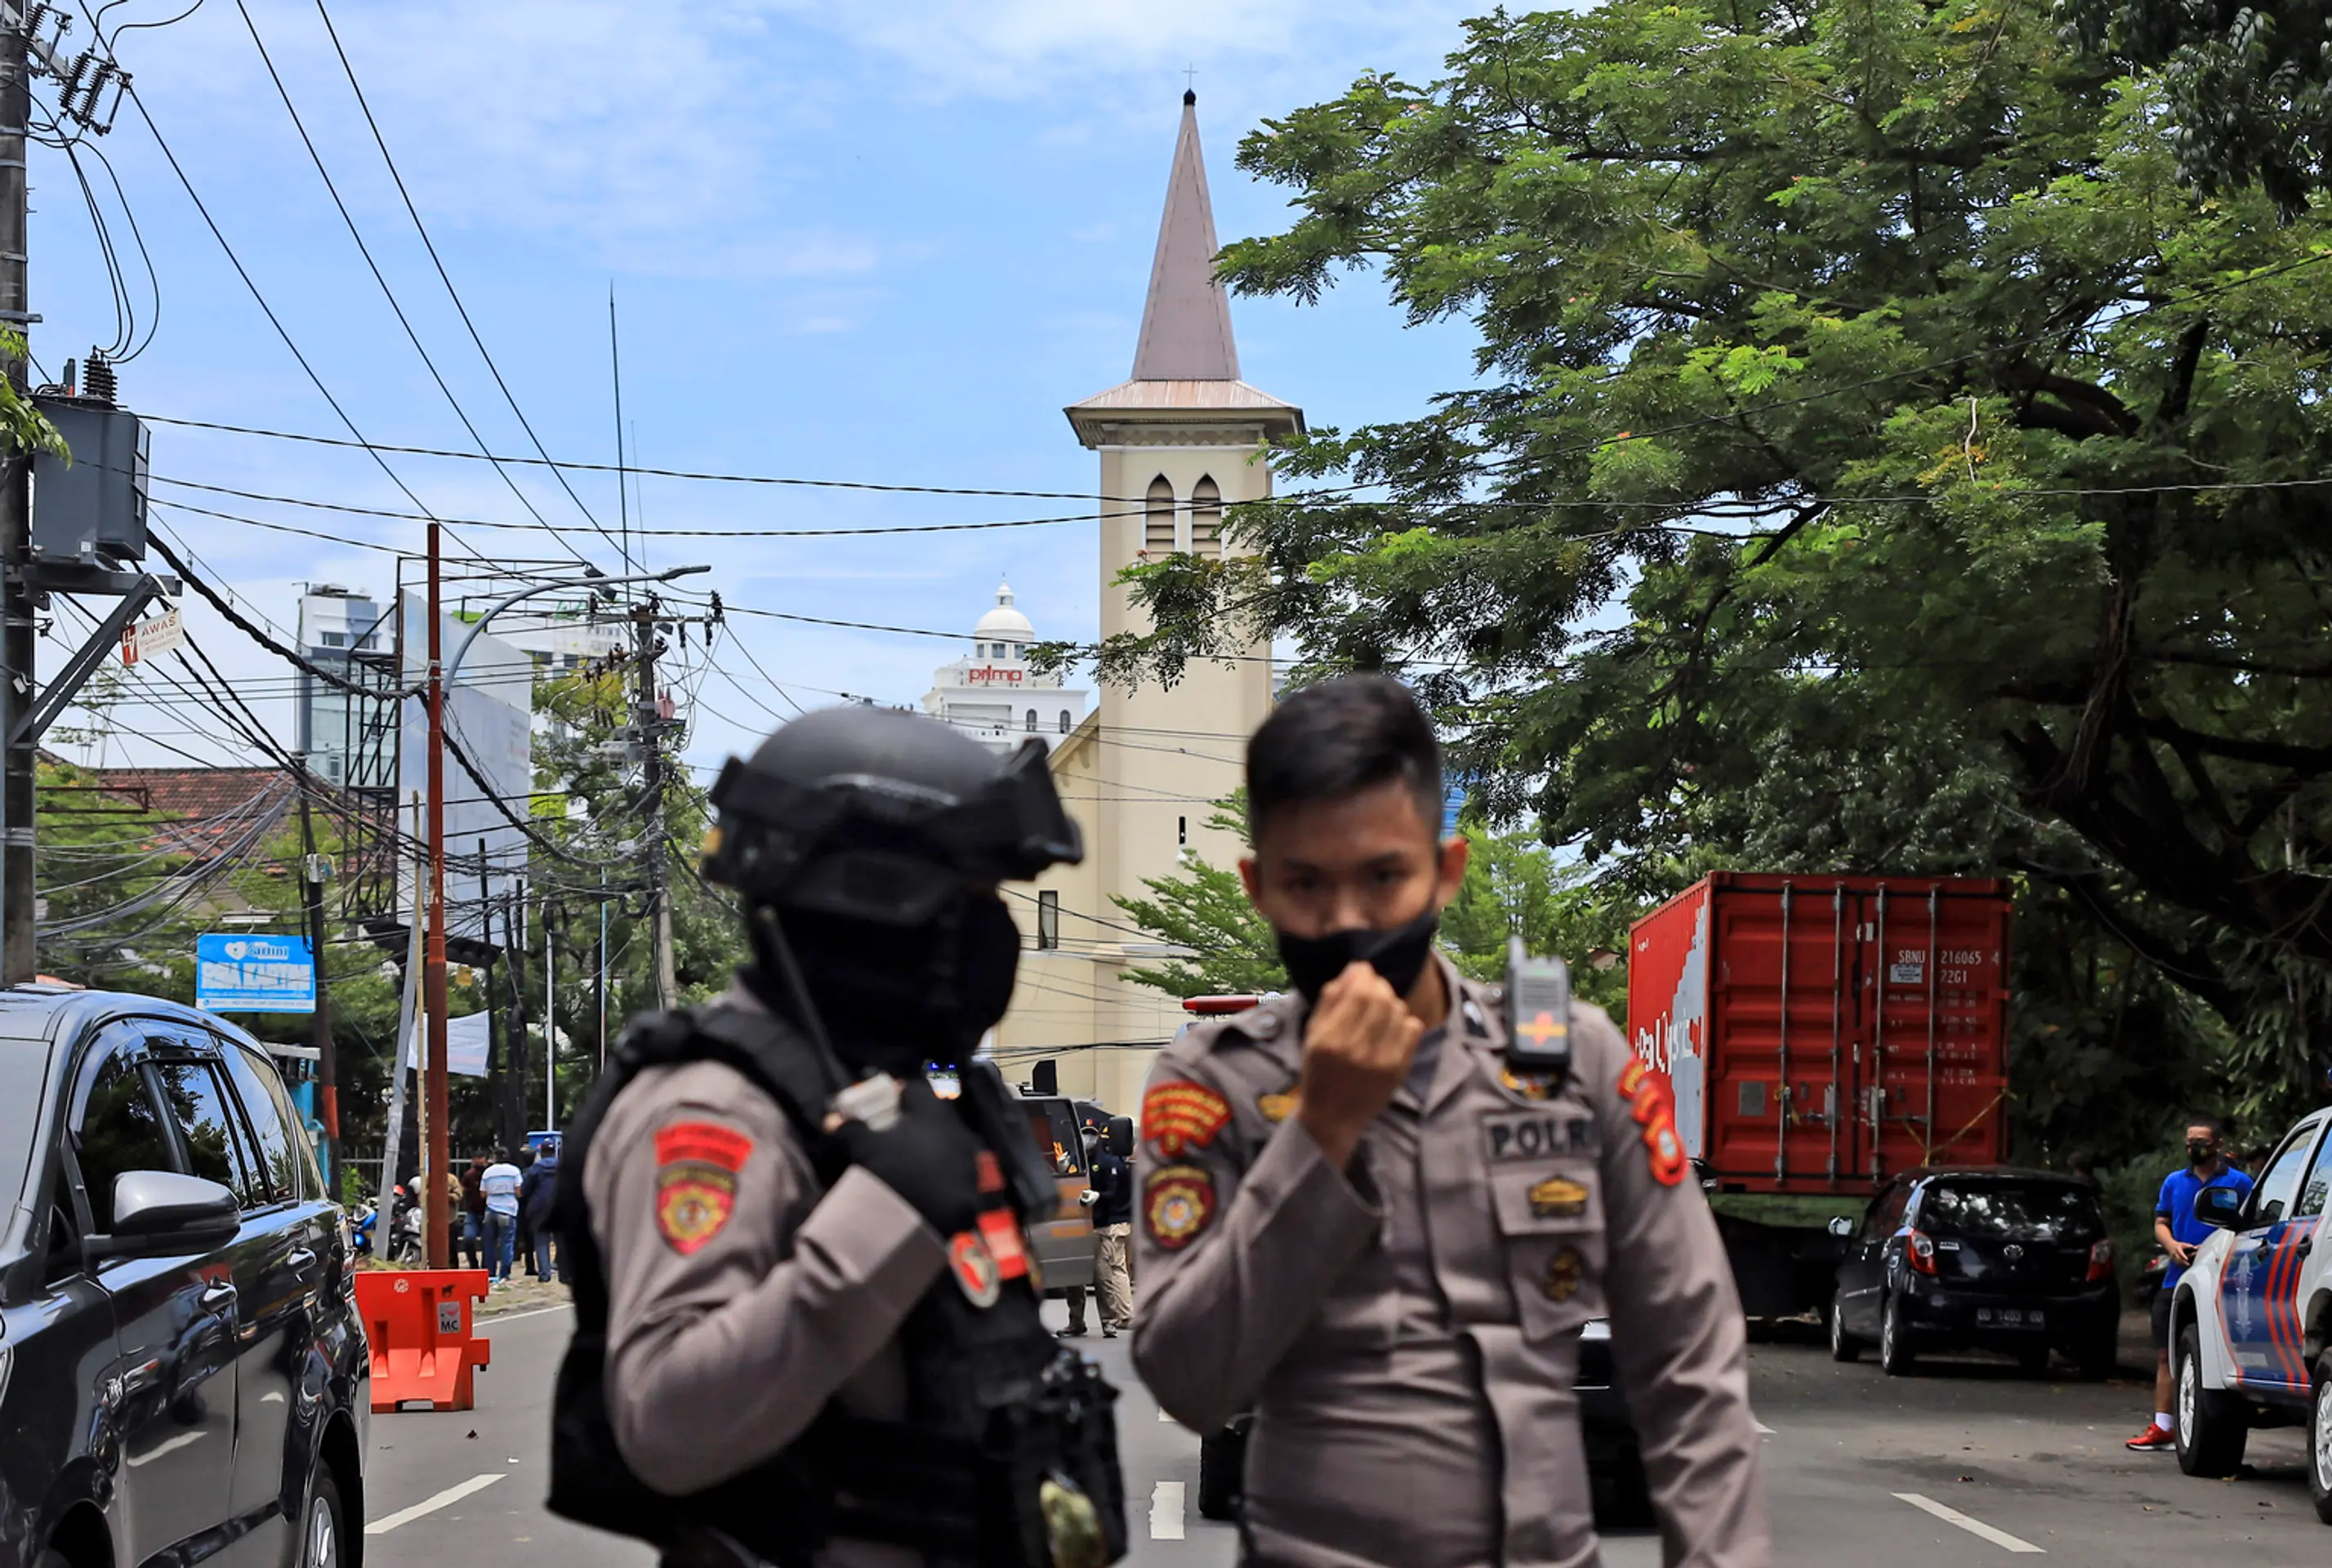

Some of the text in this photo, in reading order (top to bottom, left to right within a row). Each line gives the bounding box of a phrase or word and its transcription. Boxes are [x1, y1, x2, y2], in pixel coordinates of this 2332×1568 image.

[141, 616, 176, 637] AWAS
[969, 664, 1023, 684] prima
[1898, 950, 1925, 964] SBNU
[1941, 951, 1982, 964] 216065
